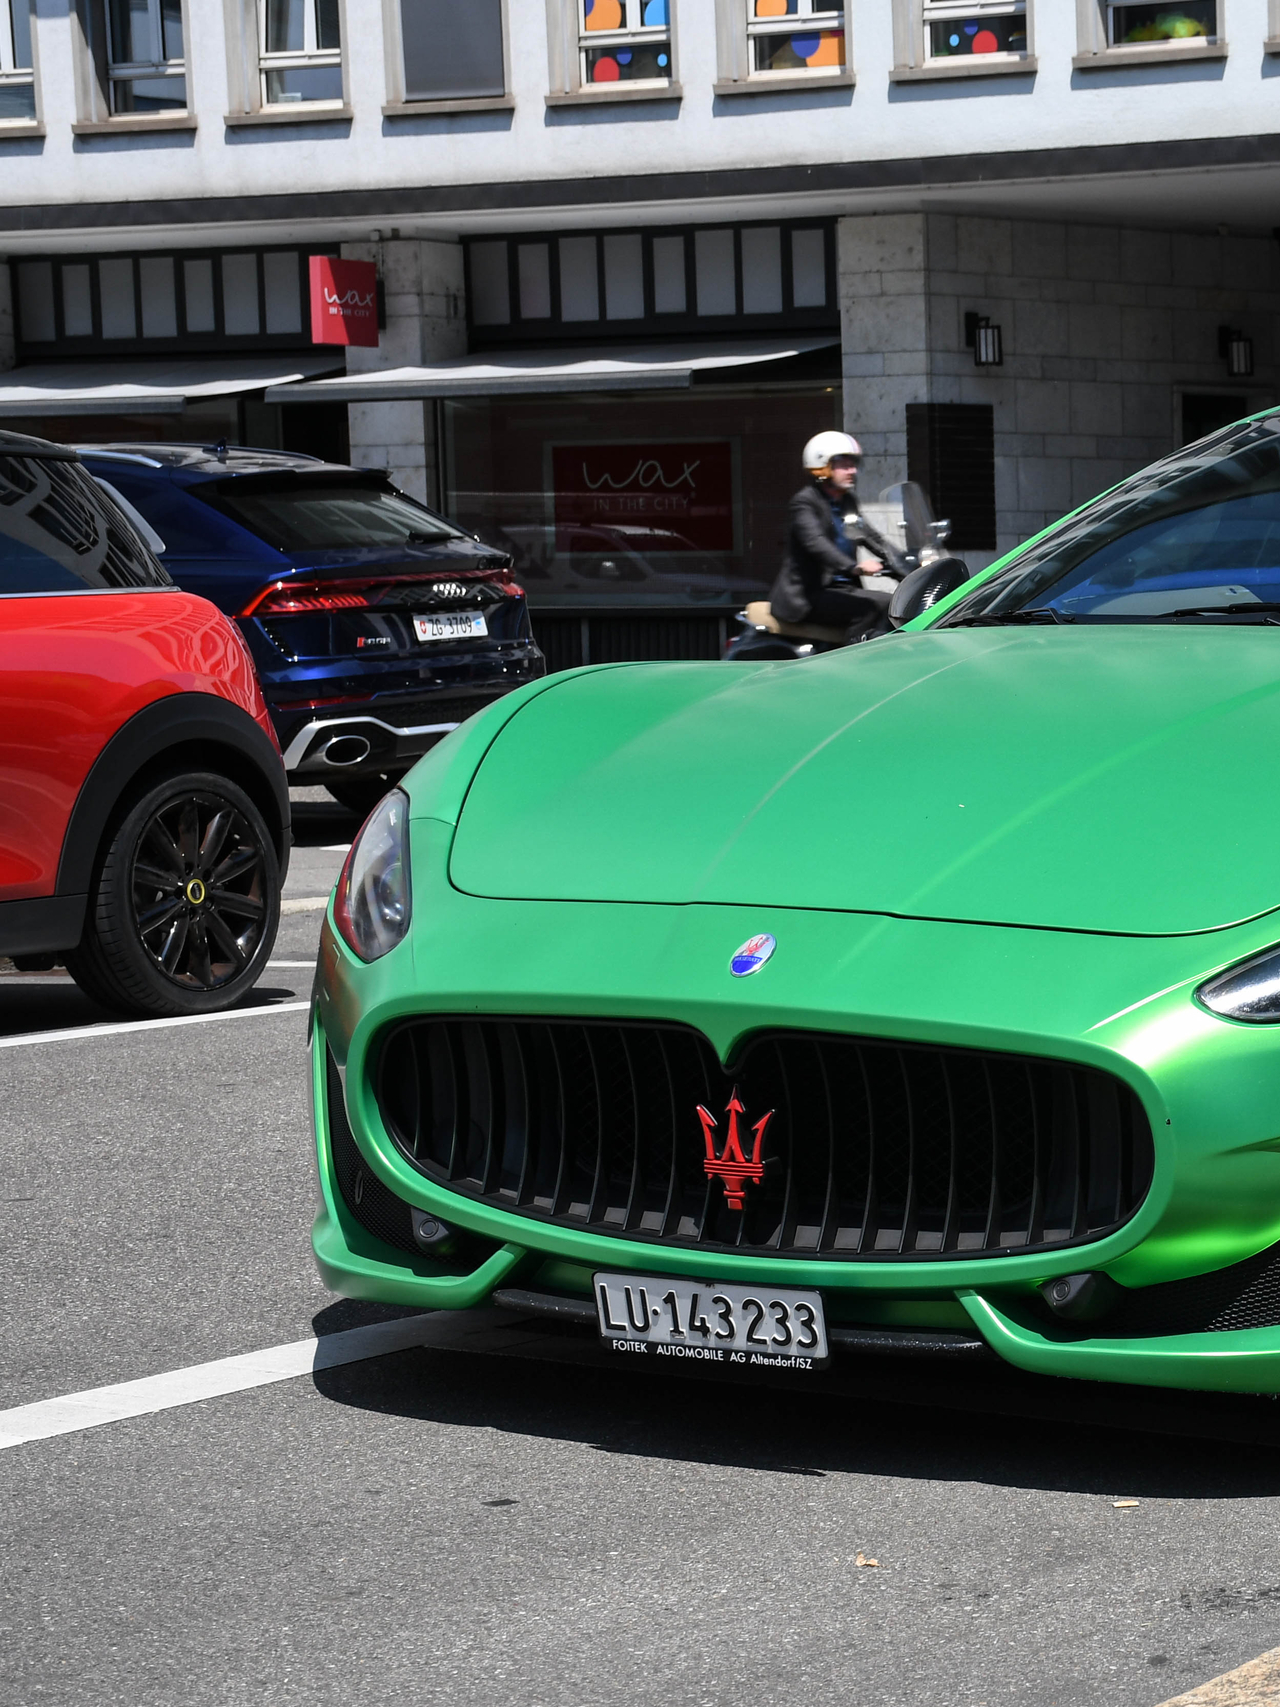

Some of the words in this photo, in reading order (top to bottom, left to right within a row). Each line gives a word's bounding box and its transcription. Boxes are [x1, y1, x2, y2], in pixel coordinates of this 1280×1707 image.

[324, 287, 374, 307] wax
[582, 459, 701, 489] wax
[594, 498, 609, 512] IN
[619, 497, 649, 511] THE
[654, 496, 689, 511] CITY
[612, 1339, 648, 1353] FOITEK
[656, 1344, 724, 1361] AUTOMOBILE
[730, 1352, 746, 1363] AG
[750, 1353, 813, 1370] Altendorf/SZ
